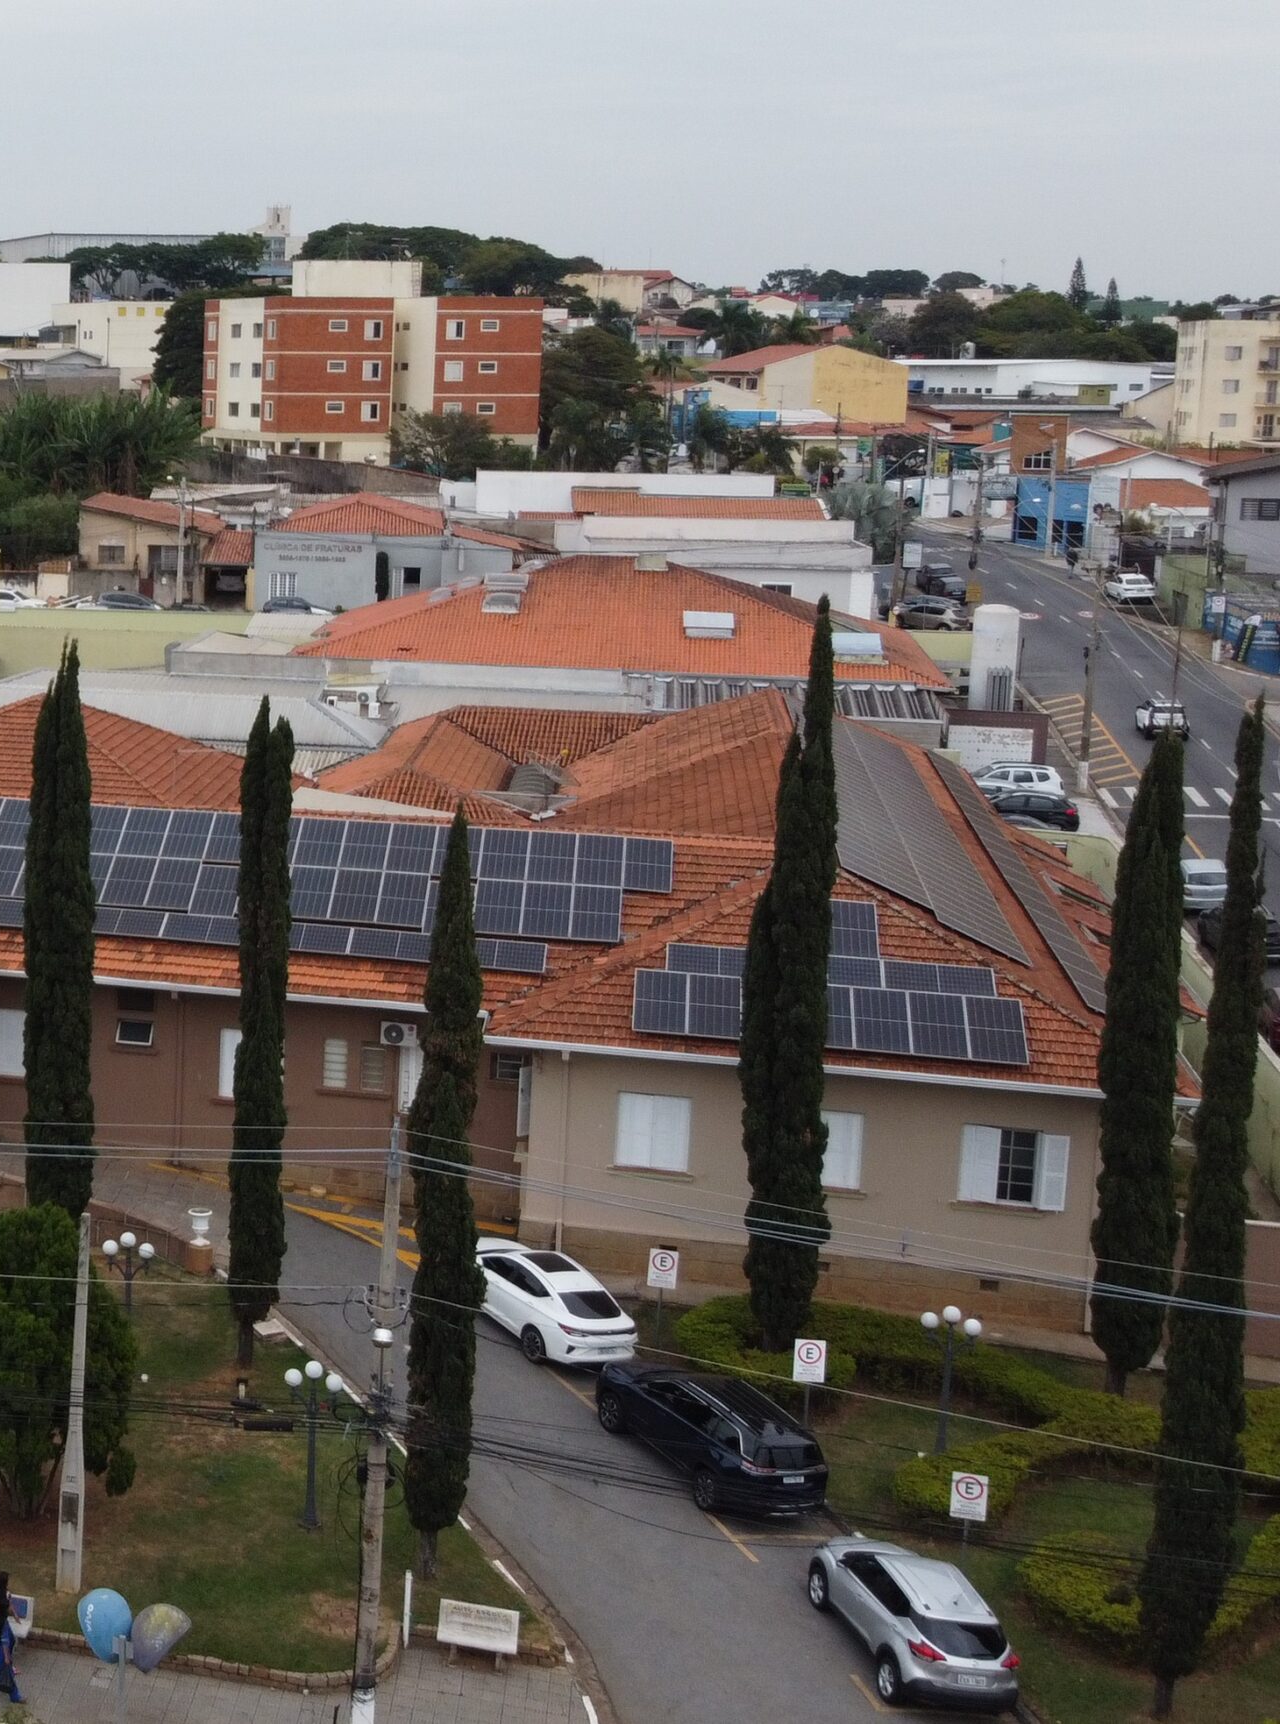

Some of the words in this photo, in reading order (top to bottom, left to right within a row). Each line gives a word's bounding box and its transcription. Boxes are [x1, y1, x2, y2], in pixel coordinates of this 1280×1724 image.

[300, 543, 313, 552] DE
[315, 544, 363, 553] FRATURAS
[660, 1256, 668, 1268] E
[806, 1347, 814, 1360] E
[965, 1482, 975, 1495] E
[84, 1603, 95, 1632] vivo
